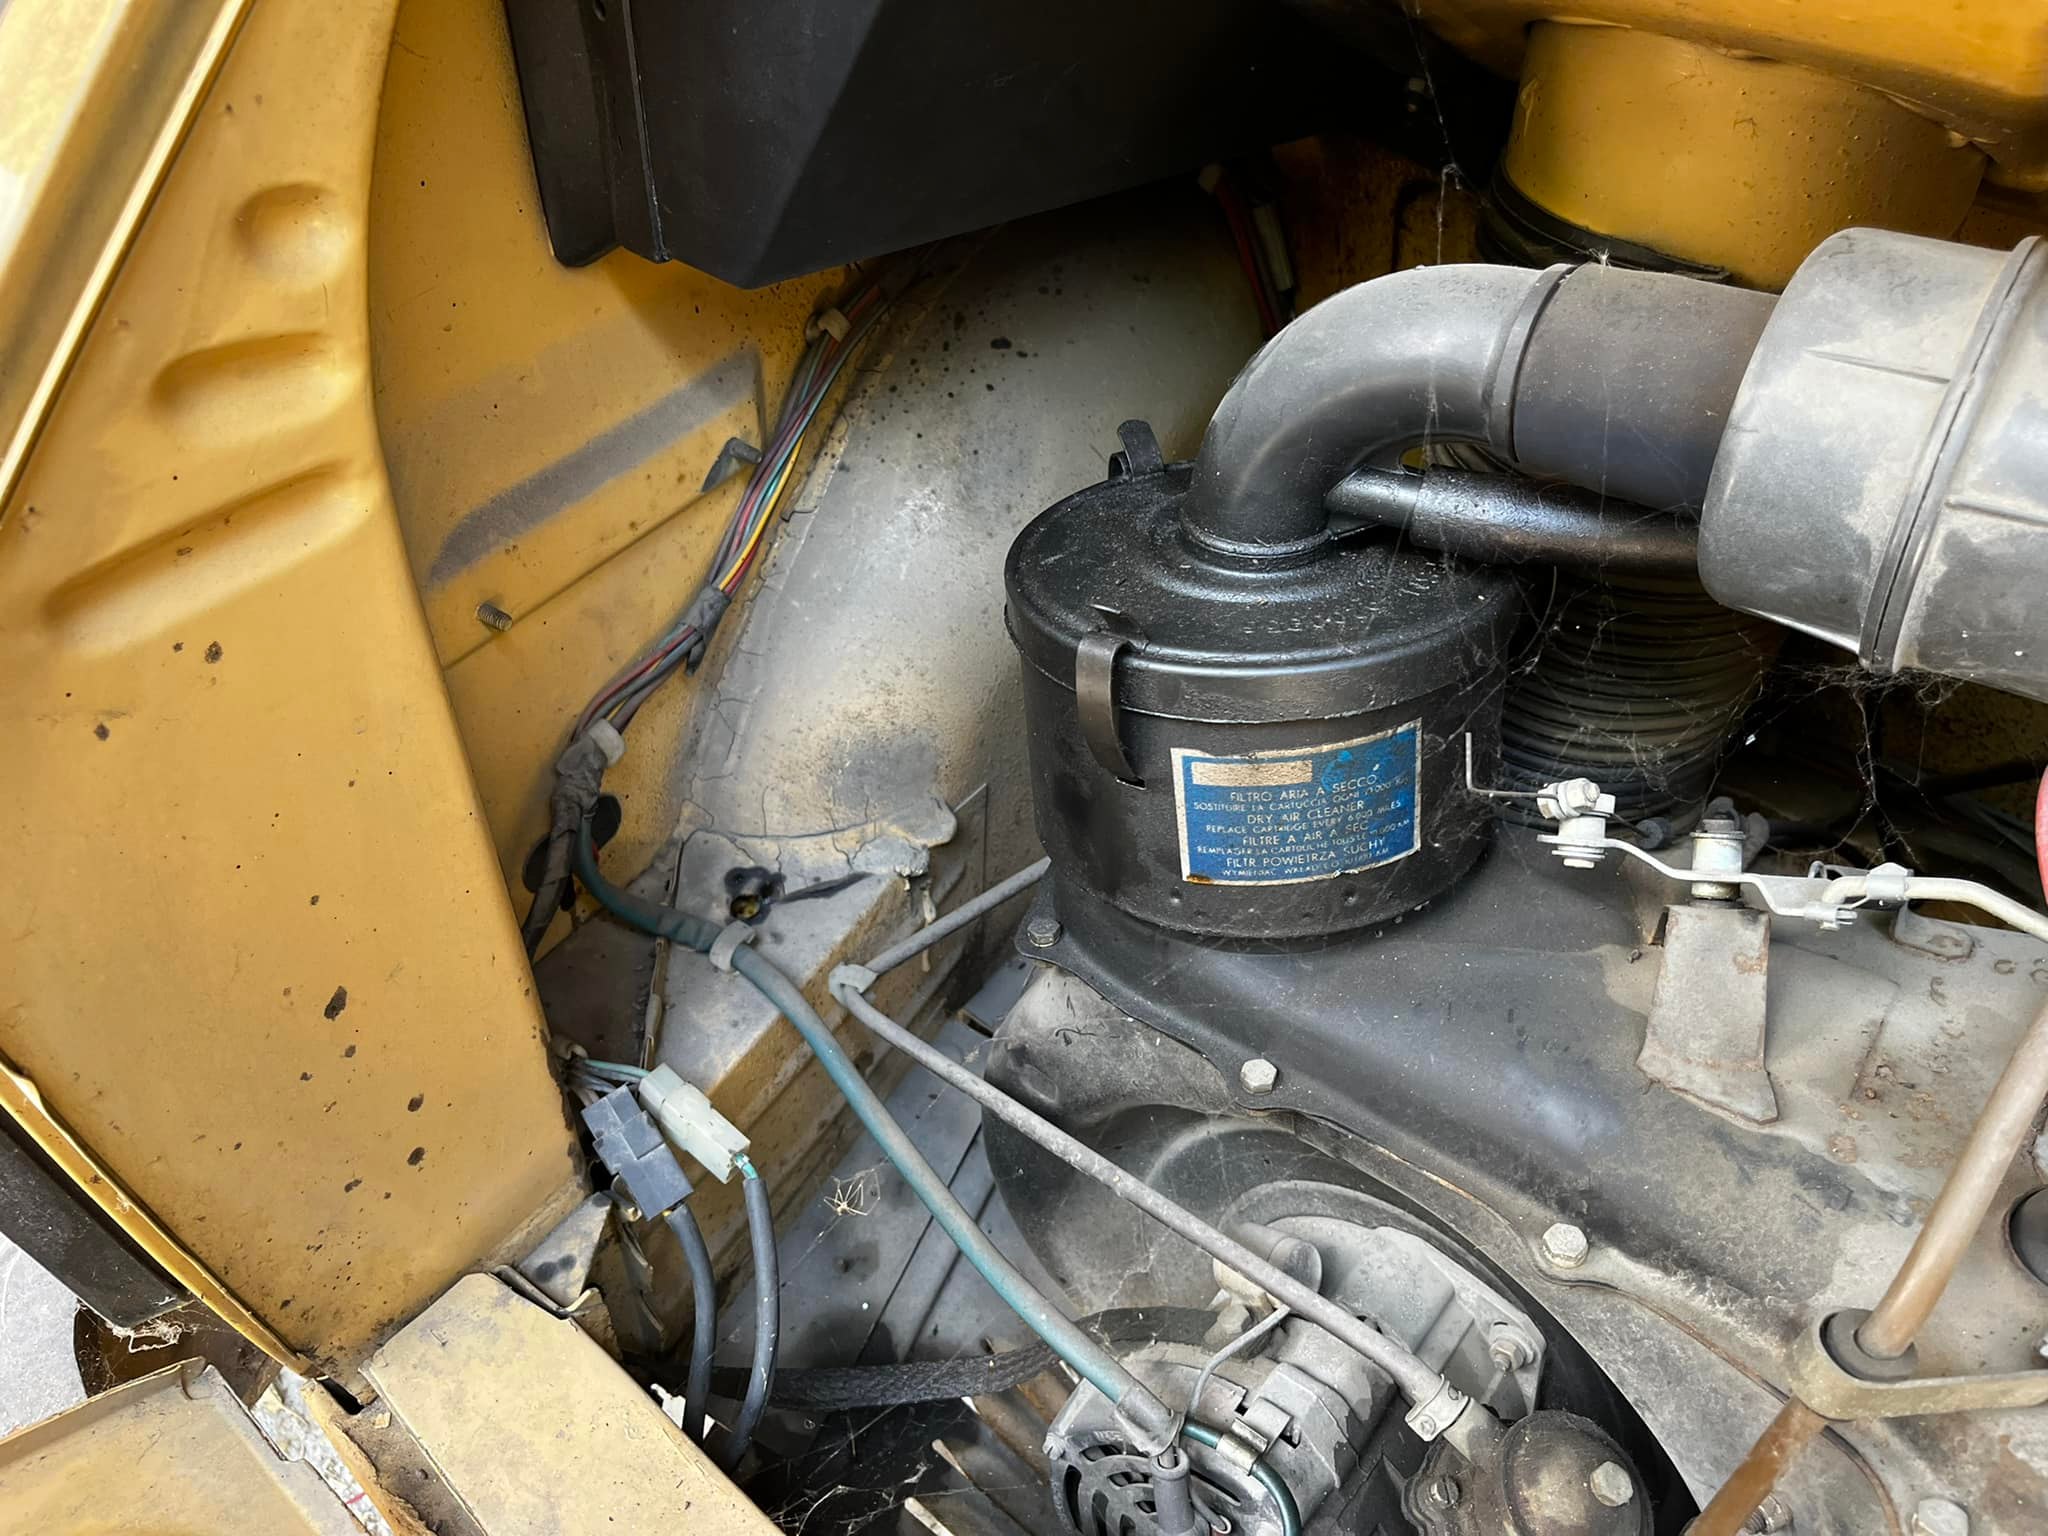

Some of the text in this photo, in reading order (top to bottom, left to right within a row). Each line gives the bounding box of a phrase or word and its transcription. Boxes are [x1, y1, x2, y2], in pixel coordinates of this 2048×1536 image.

[1230, 774, 1377, 802] FILTRO ARIA A SECCO
[1247, 800, 1364, 825] DRY AIR CLEANER
[1206, 824, 1246, 833] REPLACE
[1243, 836, 1279, 846] FILTRE
[1287, 835, 1296, 843] A
[1303, 832, 1322, 842] AIR
[1330, 829, 1338, 837] A
[1227, 856, 1256, 867] FILTR
